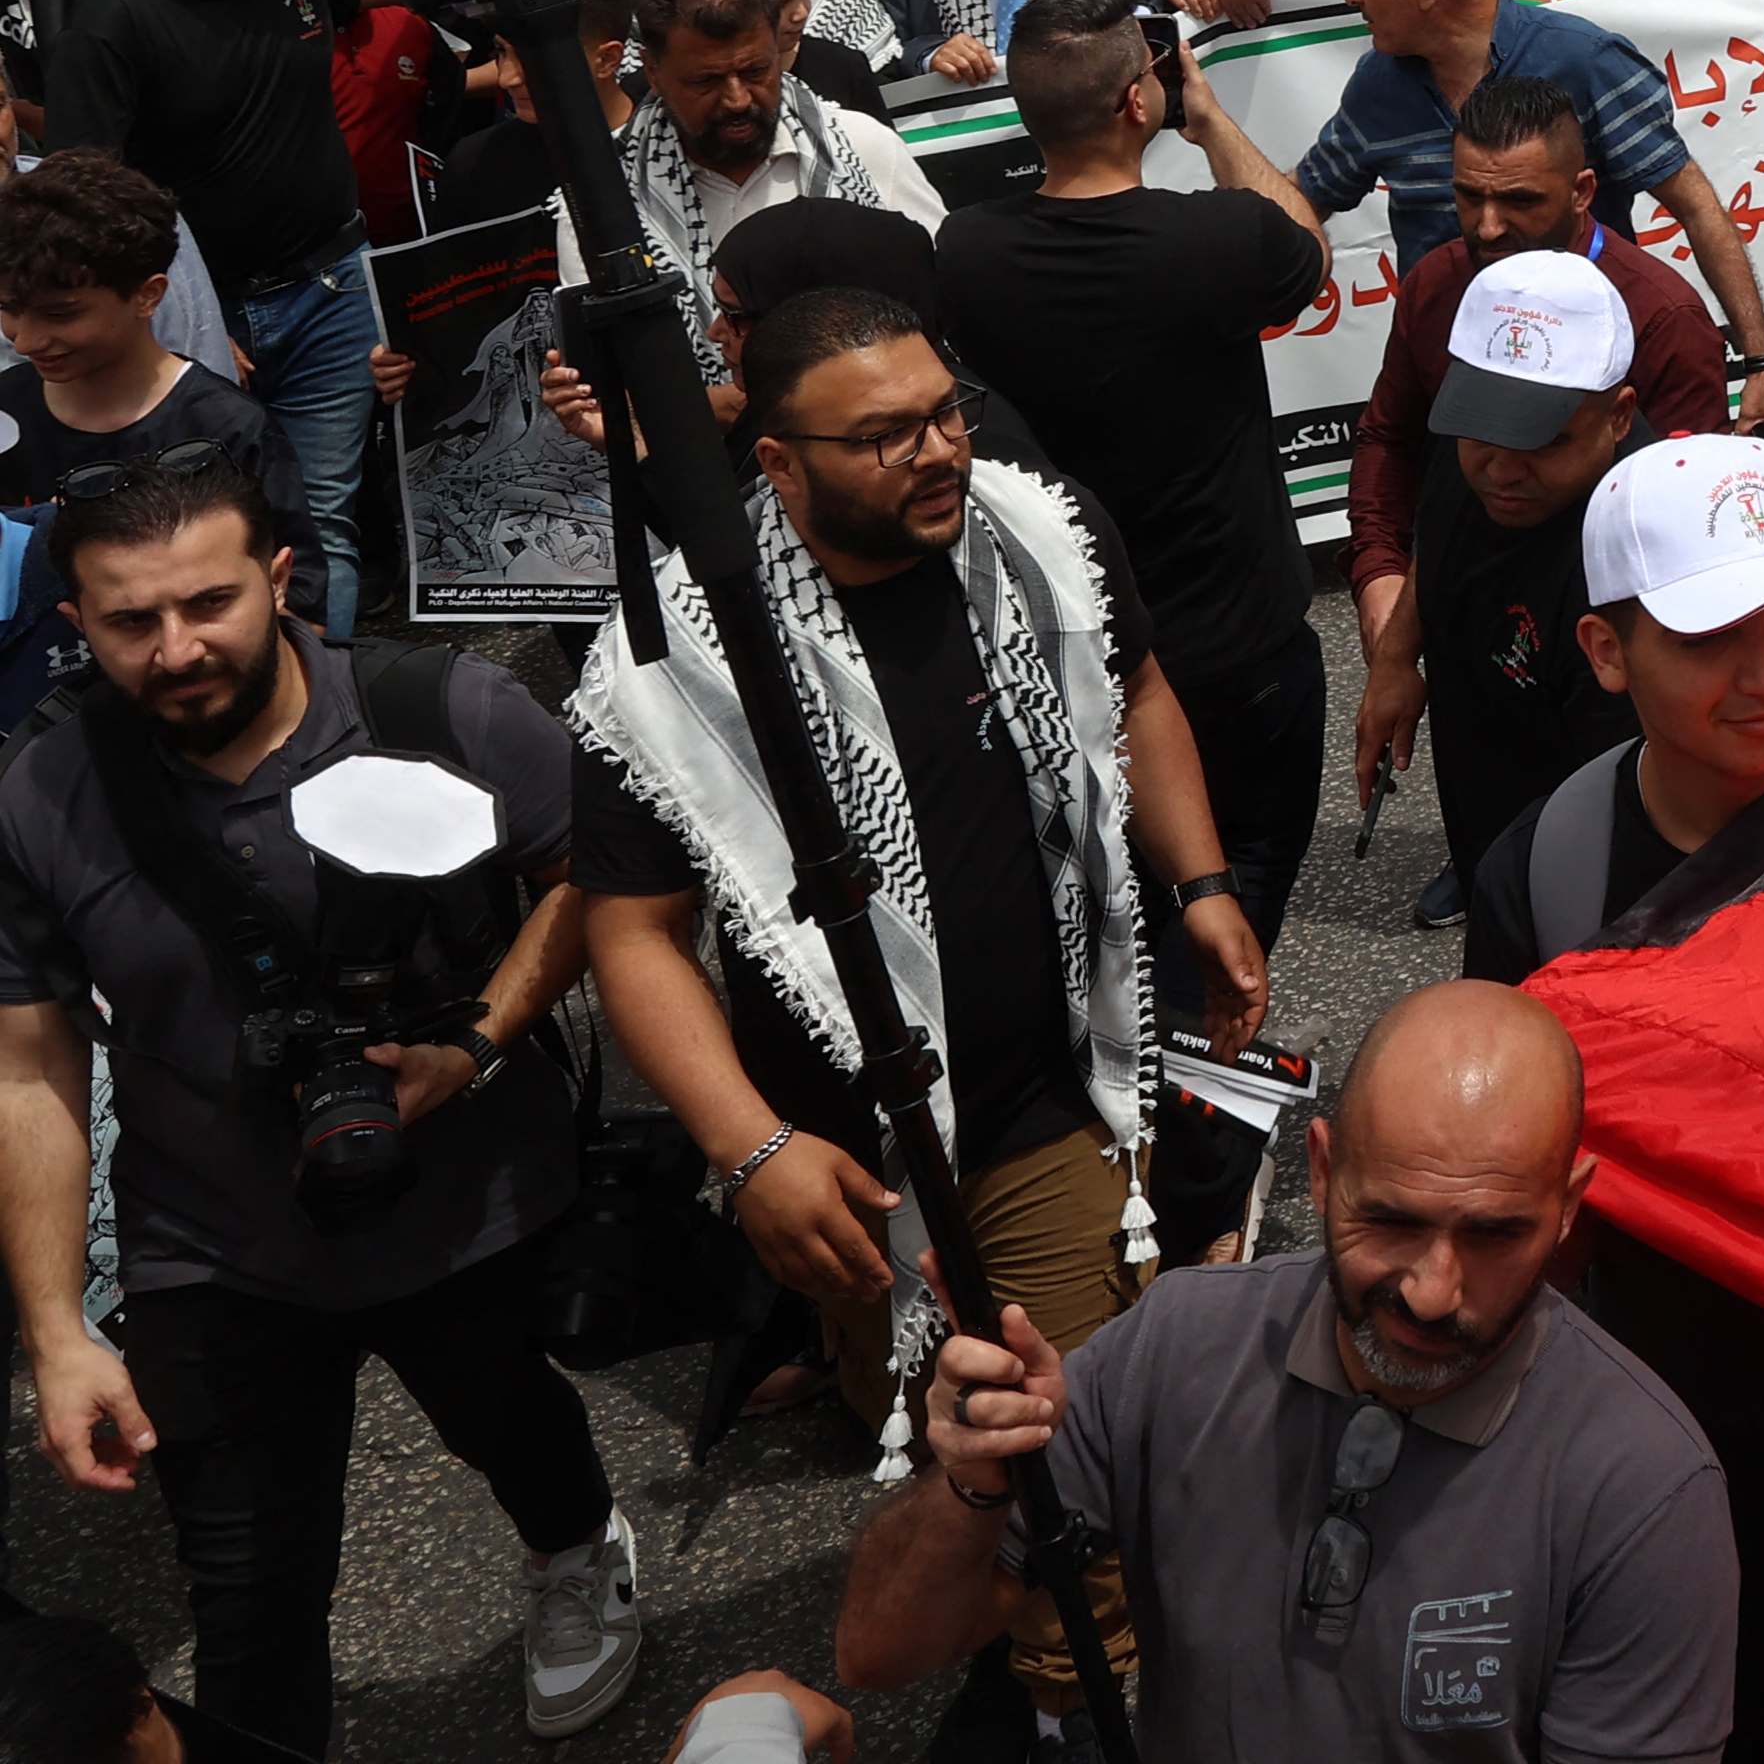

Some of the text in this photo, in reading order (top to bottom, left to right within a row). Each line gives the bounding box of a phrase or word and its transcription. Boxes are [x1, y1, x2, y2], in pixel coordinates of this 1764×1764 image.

[1278, 421, 1350, 462] النكب
[428, 588, 457, 599] النكبة
[334, 1025, 367, 1034] Canon
